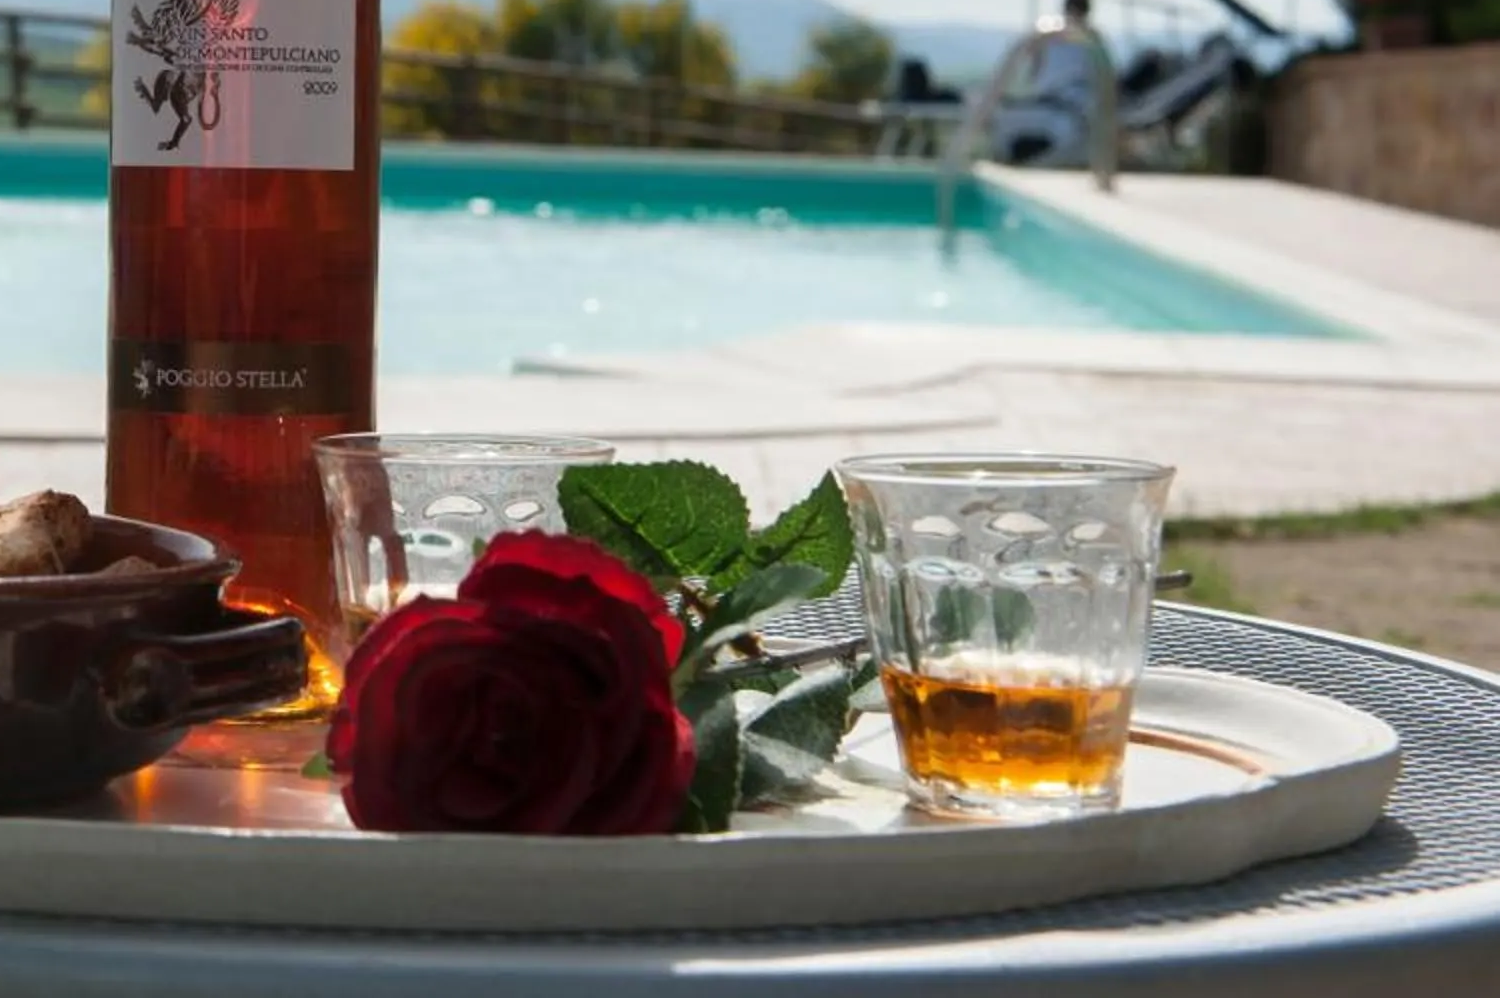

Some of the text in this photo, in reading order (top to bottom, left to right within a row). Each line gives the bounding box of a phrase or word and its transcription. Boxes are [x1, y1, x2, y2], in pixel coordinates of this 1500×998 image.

[210, 27, 268, 41] SANTO
[197, 46, 342, 64] MONTEPULCIANO
[302, 81, 339, 95] 2009
[156, 368, 304, 389] POGGIO STELLA
